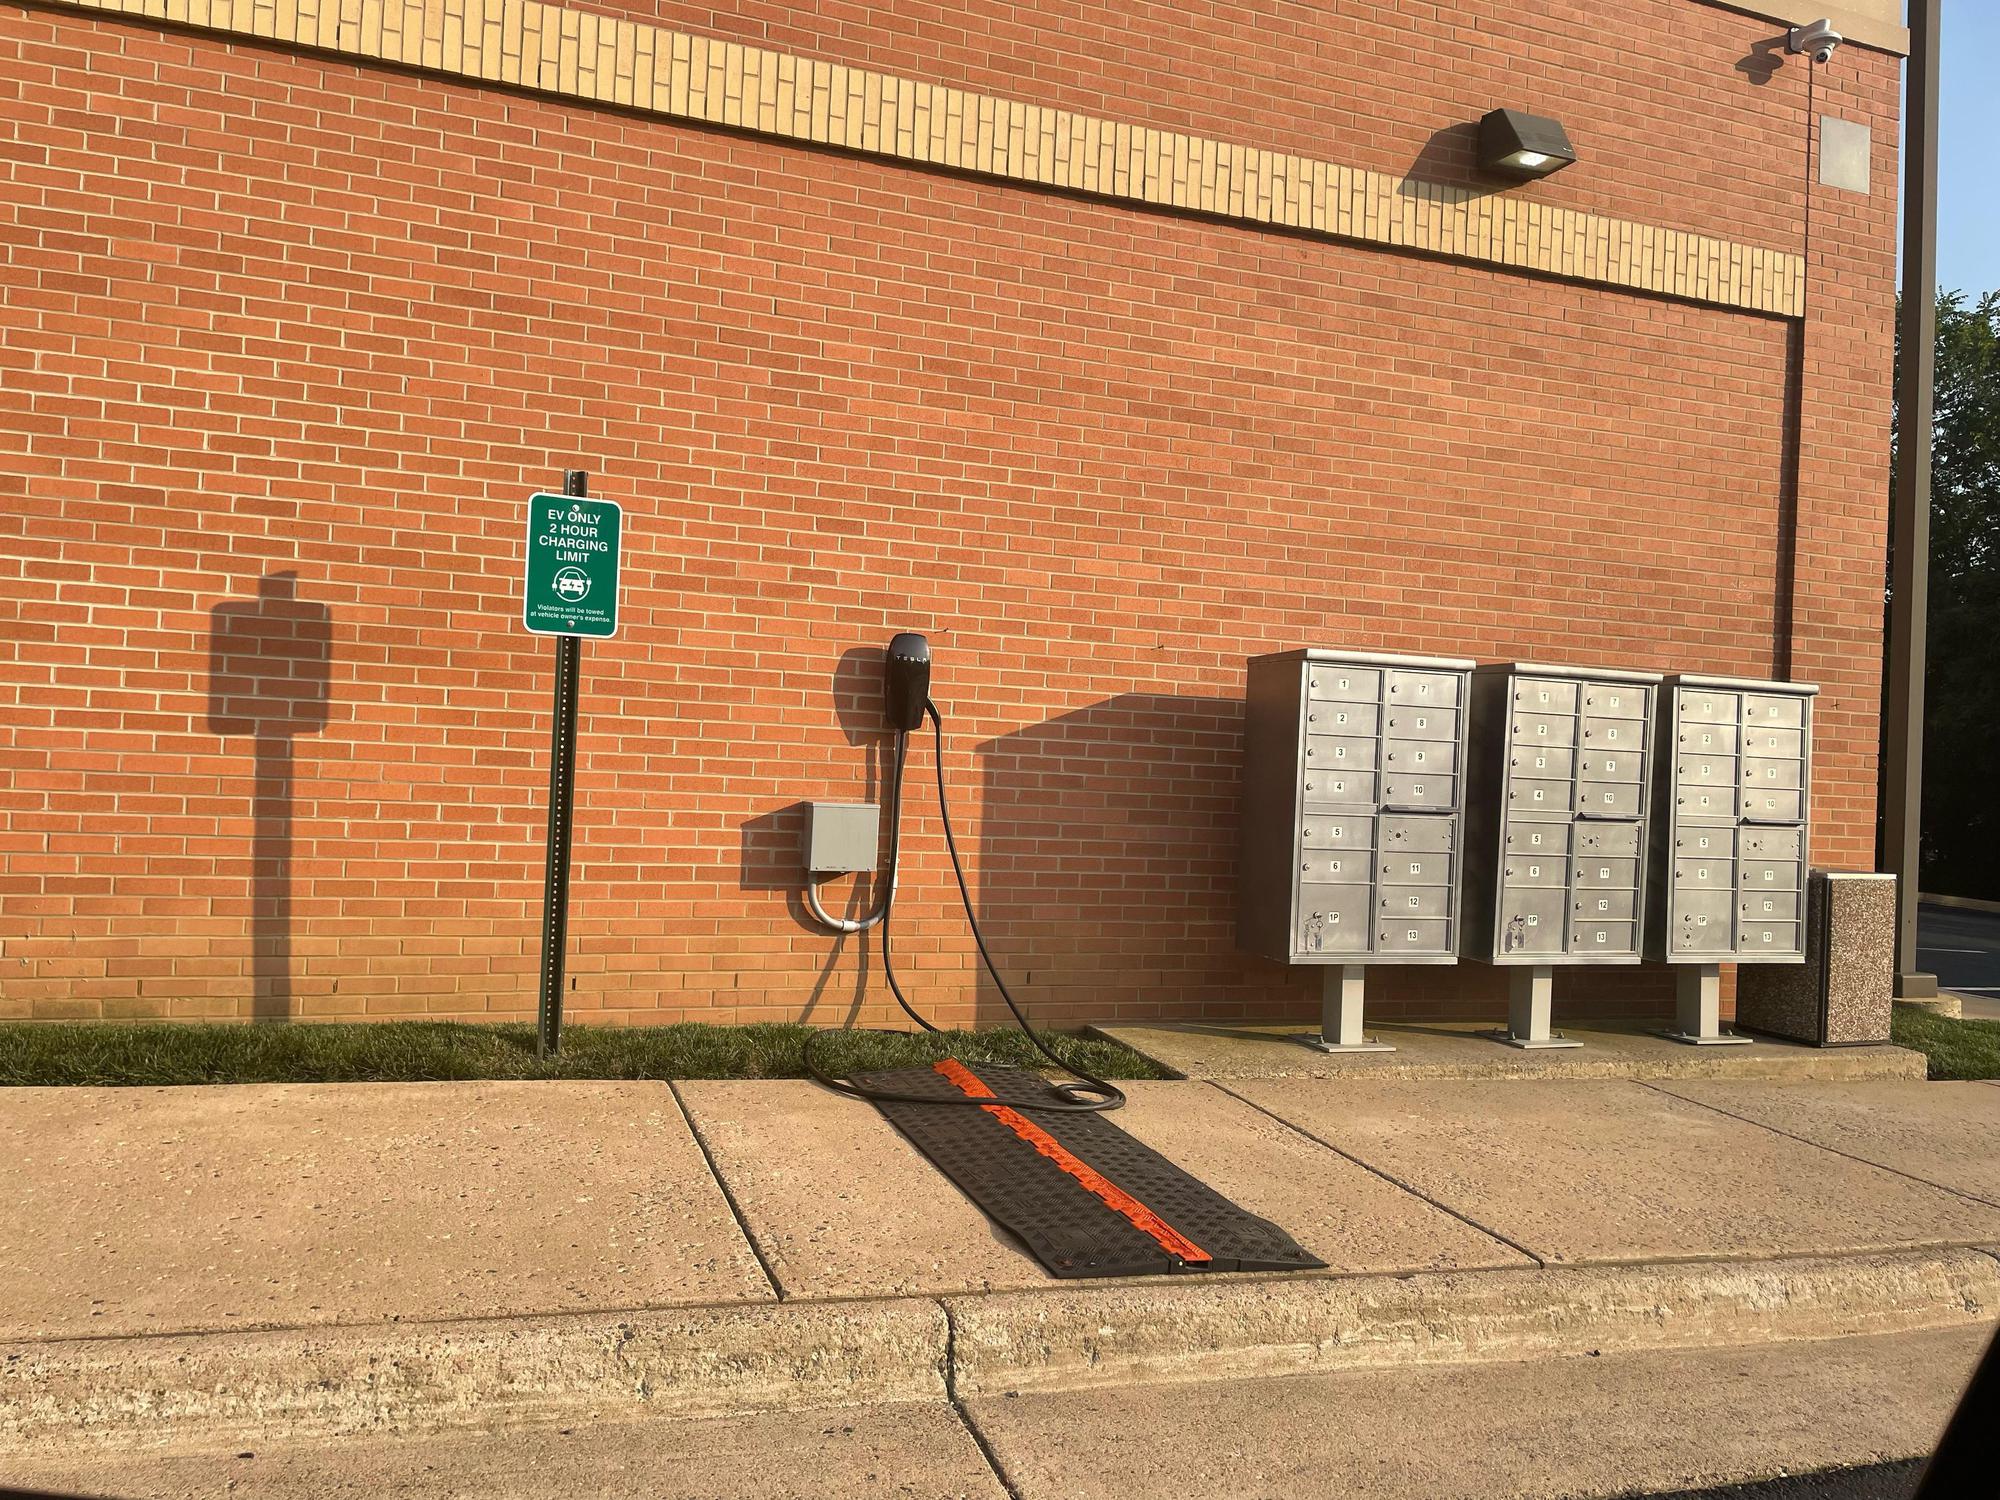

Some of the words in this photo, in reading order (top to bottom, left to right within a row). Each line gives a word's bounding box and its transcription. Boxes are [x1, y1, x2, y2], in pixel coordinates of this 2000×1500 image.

[548, 509, 564, 521] EV
[568, 511, 601, 525] ONLY
[549, 523, 557, 533] 2
[561, 524, 598, 538] HOUR
[539, 535, 608, 552] CHARGING
[556, 550, 590, 563] LIMIT
[537, 604, 564, 612] Violators
[1414, 786, 1423, 794] 10
[1605, 794, 1613, 802] 10
[1601, 869, 1609, 877] 11
[1410, 898, 1418, 906] 12
[1599, 901, 1607, 909] 12
[1330, 913, 1339, 921] 1P
[1529, 916, 1537, 924] 1P
[1408, 931, 1417, 939] 13
[1597, 933, 1605, 941] 13
